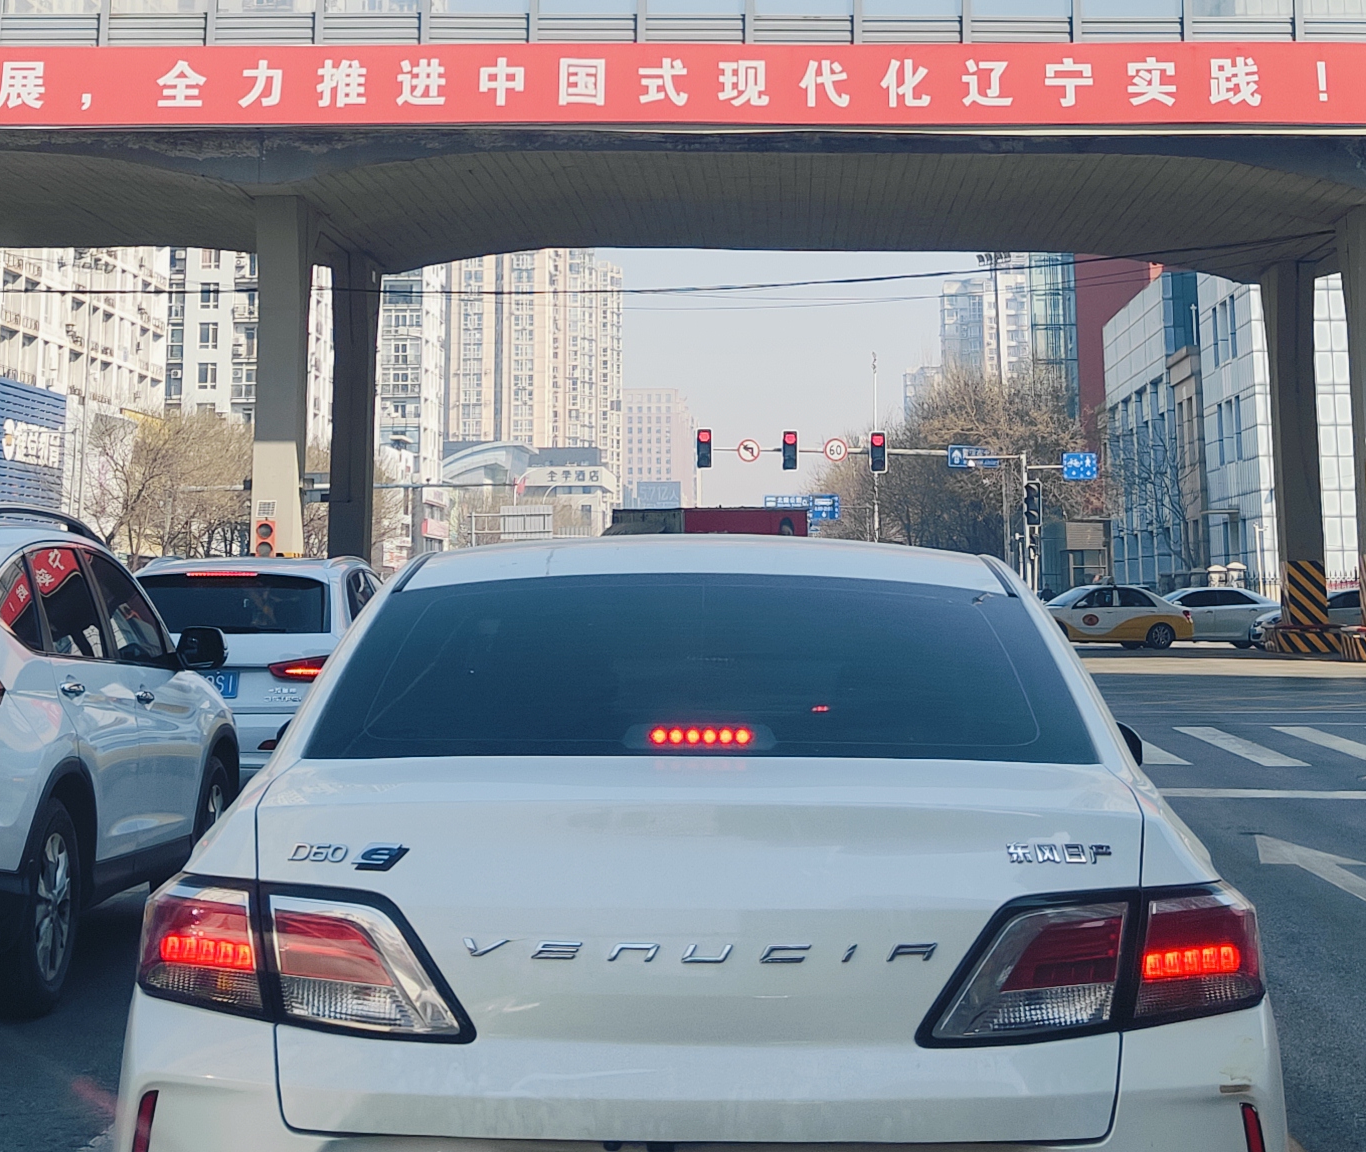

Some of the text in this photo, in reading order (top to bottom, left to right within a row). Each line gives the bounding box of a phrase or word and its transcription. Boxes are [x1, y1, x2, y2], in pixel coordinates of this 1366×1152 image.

[829, 445, 842, 456] 60
[547, 470, 599, 482] 全季酒店
[288, 843, 348, 863] D60
[1006, 842, 1112, 864] 东风日产
[462, 936, 939, 964] VENUCIA
